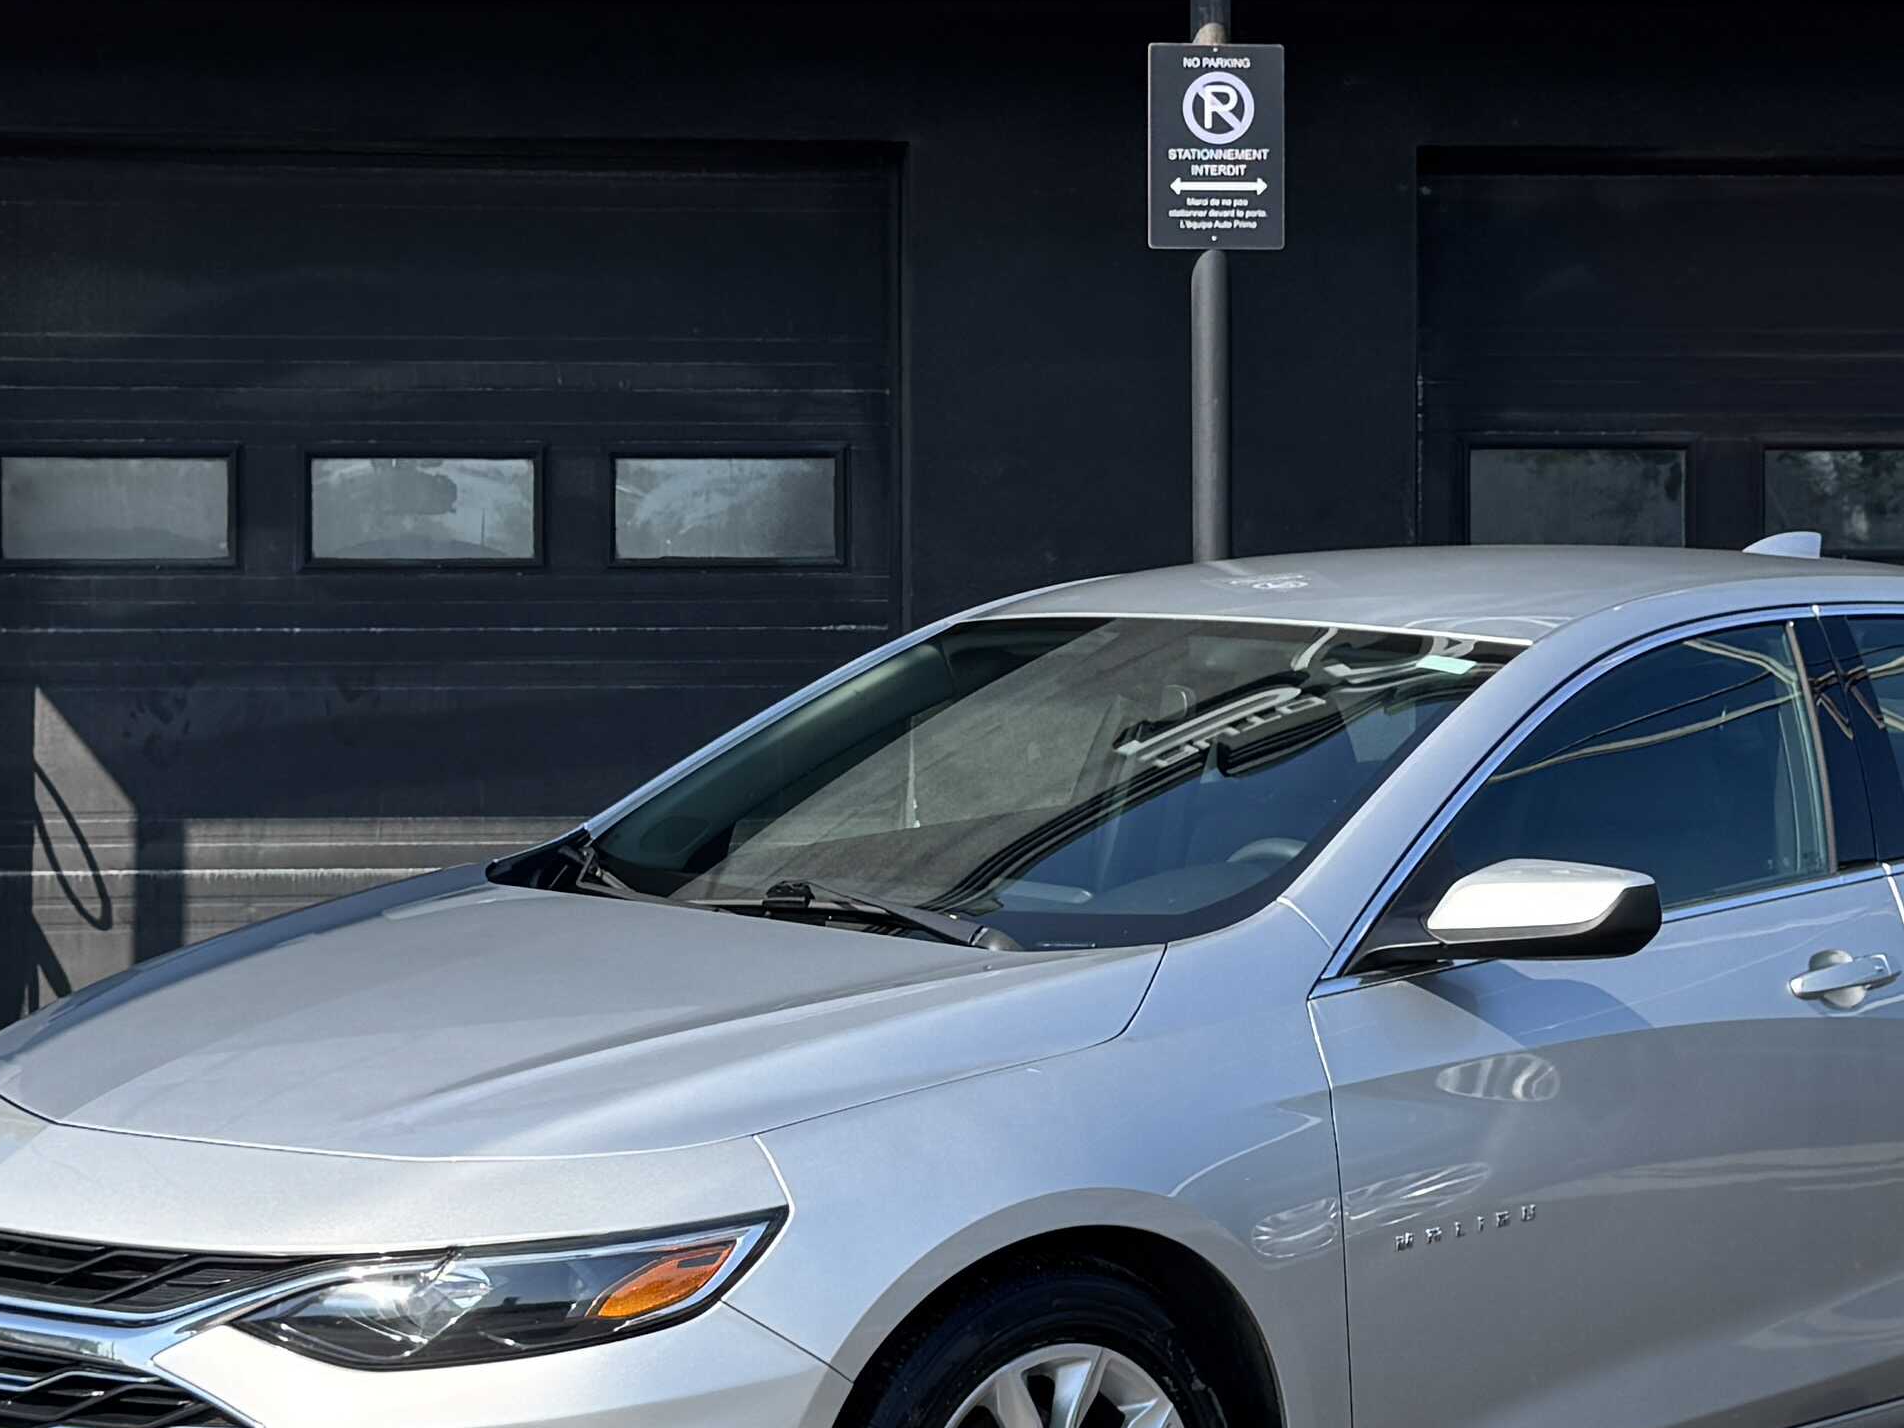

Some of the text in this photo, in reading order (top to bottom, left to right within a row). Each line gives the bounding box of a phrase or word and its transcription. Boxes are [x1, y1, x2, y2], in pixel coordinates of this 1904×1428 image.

[1182, 57, 1251, 69] NO PARKING
[1168, 148, 1270, 161] STATIONNEMENT
[1190, 164, 1247, 177] INTERDIT
[1214, 220, 1232, 229] Auto
[1233, 220, 1257, 229] Primo
